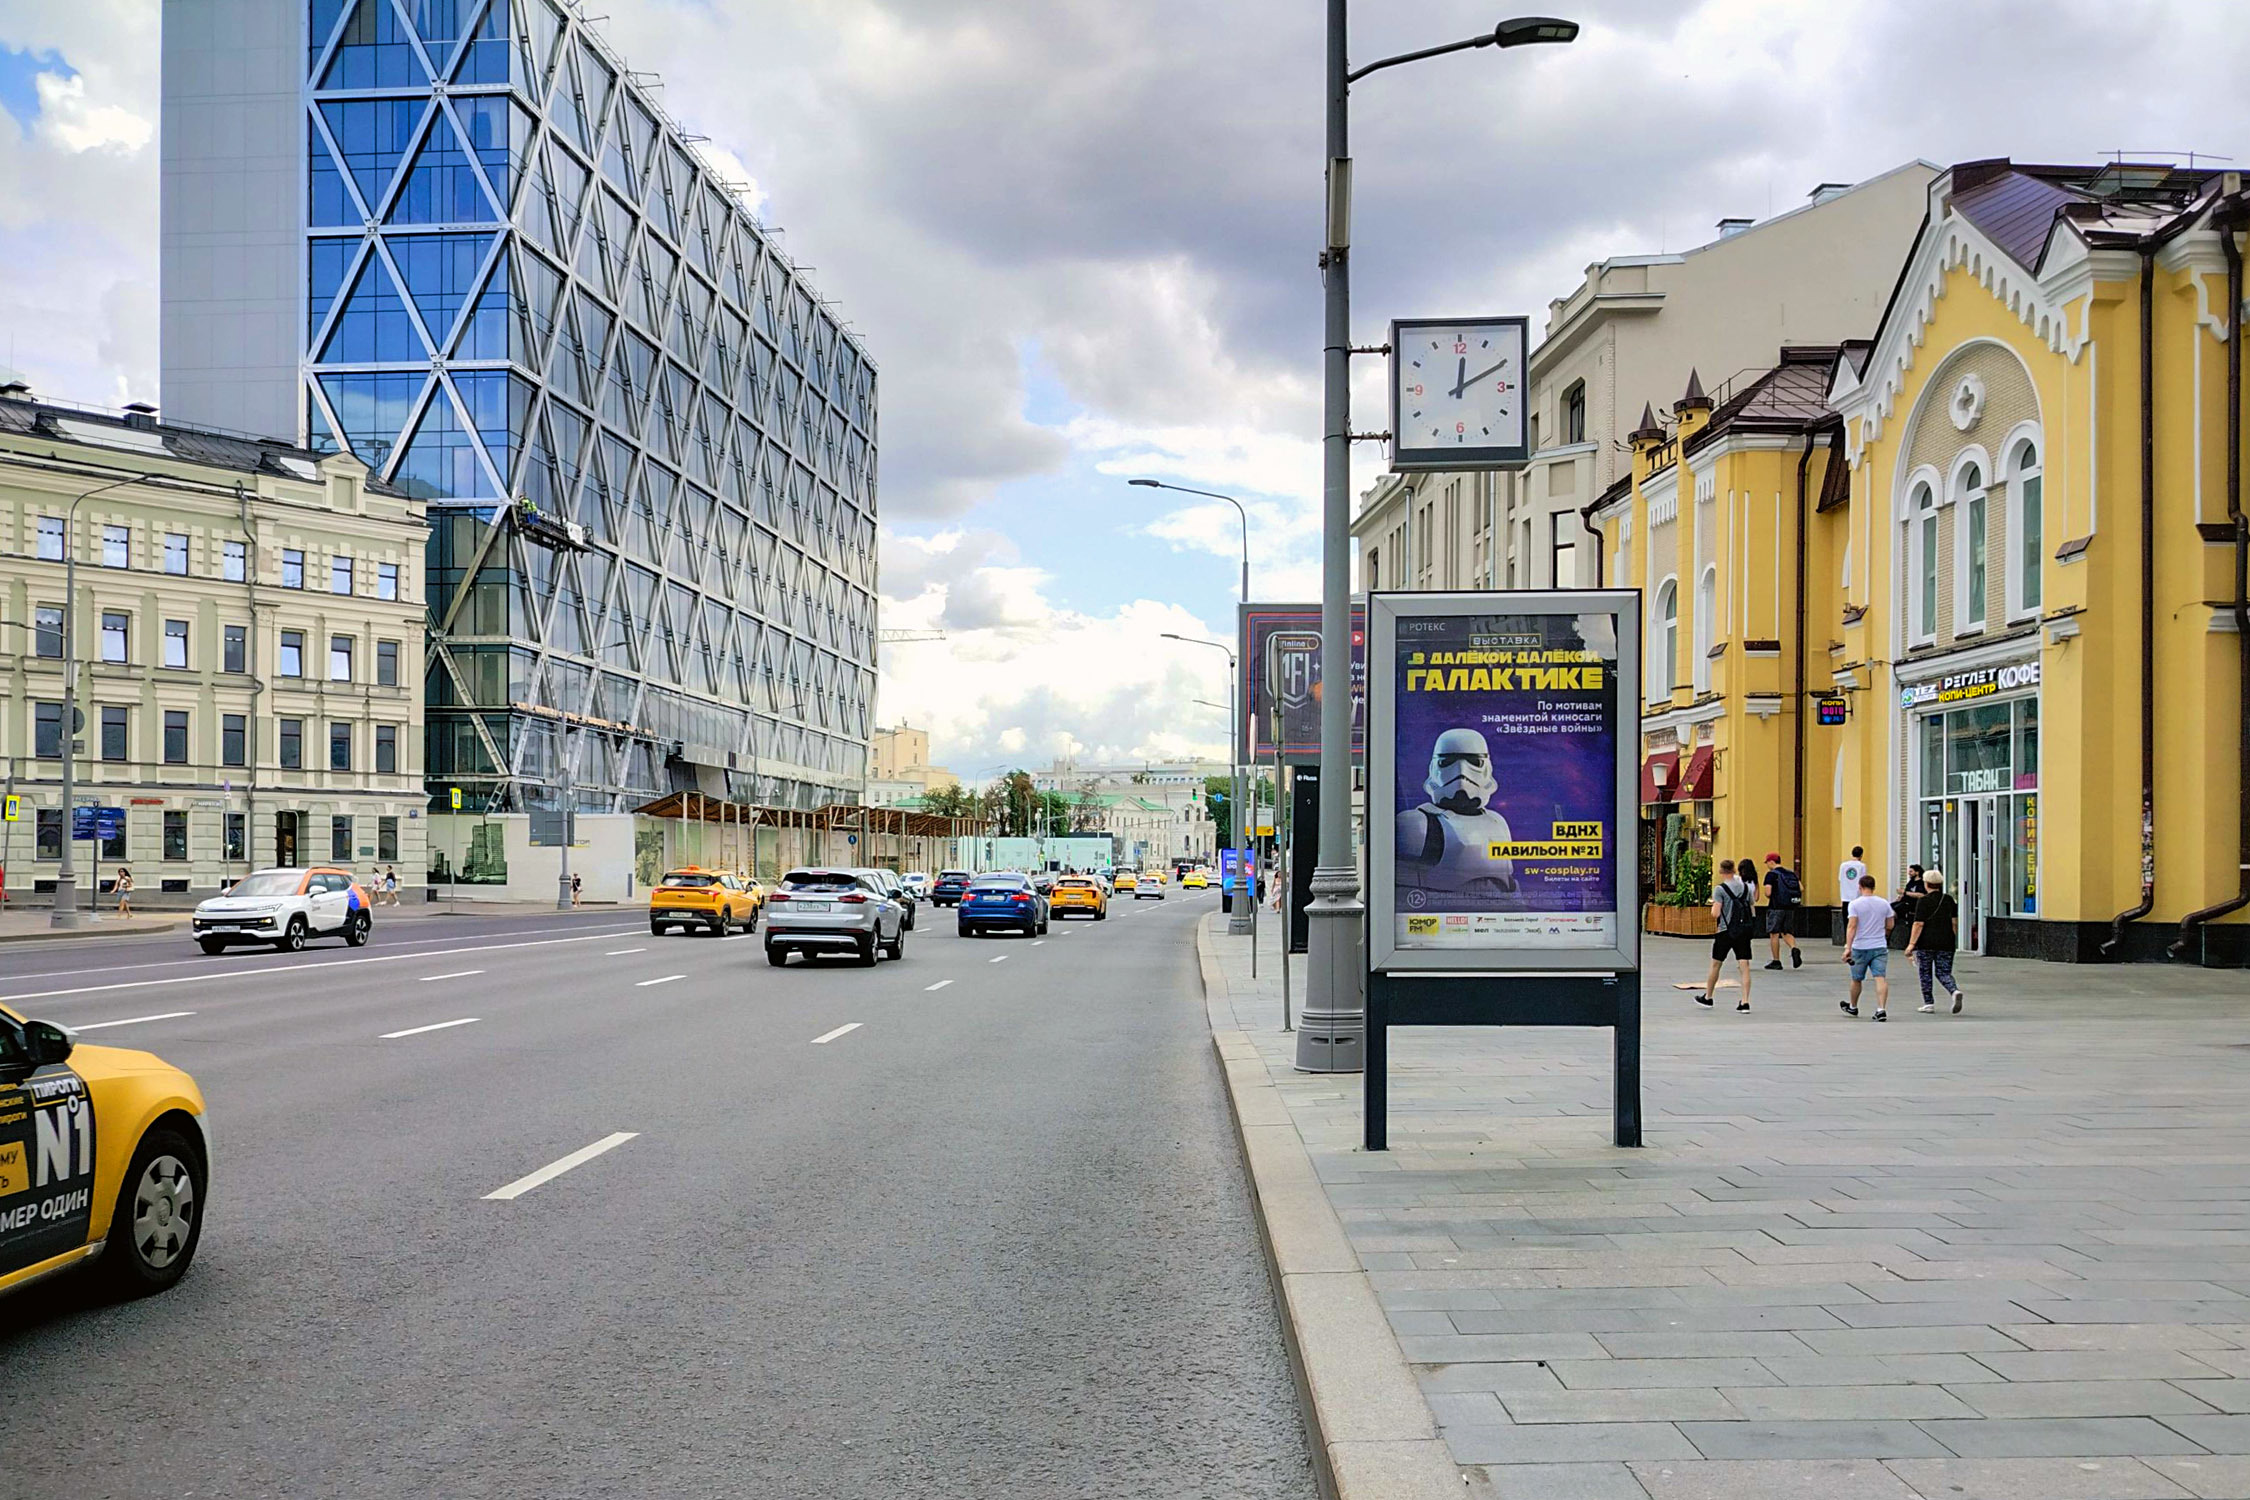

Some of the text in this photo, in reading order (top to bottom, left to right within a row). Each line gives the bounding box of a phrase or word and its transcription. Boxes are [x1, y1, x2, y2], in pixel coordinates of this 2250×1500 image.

[1453, 343, 1467, 354] 12
[1414, 385, 1423, 396] 9
[1497, 382, 1506, 393] 3
[1456, 422, 1465, 433] 6
[1409, 622, 1446, 632] РОТЕКС
[1473, 636, 1538, 645] ВЫСТАВКА
[1407, 667, 1603, 691] ГАЛАКТИКЕ
[1944, 669, 1997, 690] РЕГЛЕТ
[1998, 662, 2040, 689] КОФЕ
[1938, 682, 1996, 703] КОПИ-ЦЕНТР
[1537, 701, 1603, 711] По мотивам
[1481, 712, 1603, 723] знаменитой киносаги
[1496, 724, 1603, 735] «Звёздные войны»
[1555, 825, 1599, 838] ВДНХ
[1492, 845, 1568, 857] ПАВИЛЬОН
[1524, 865, 1600, 876] sw-cosplay.ru
[40, 1187, 89, 1221] ОДИН
